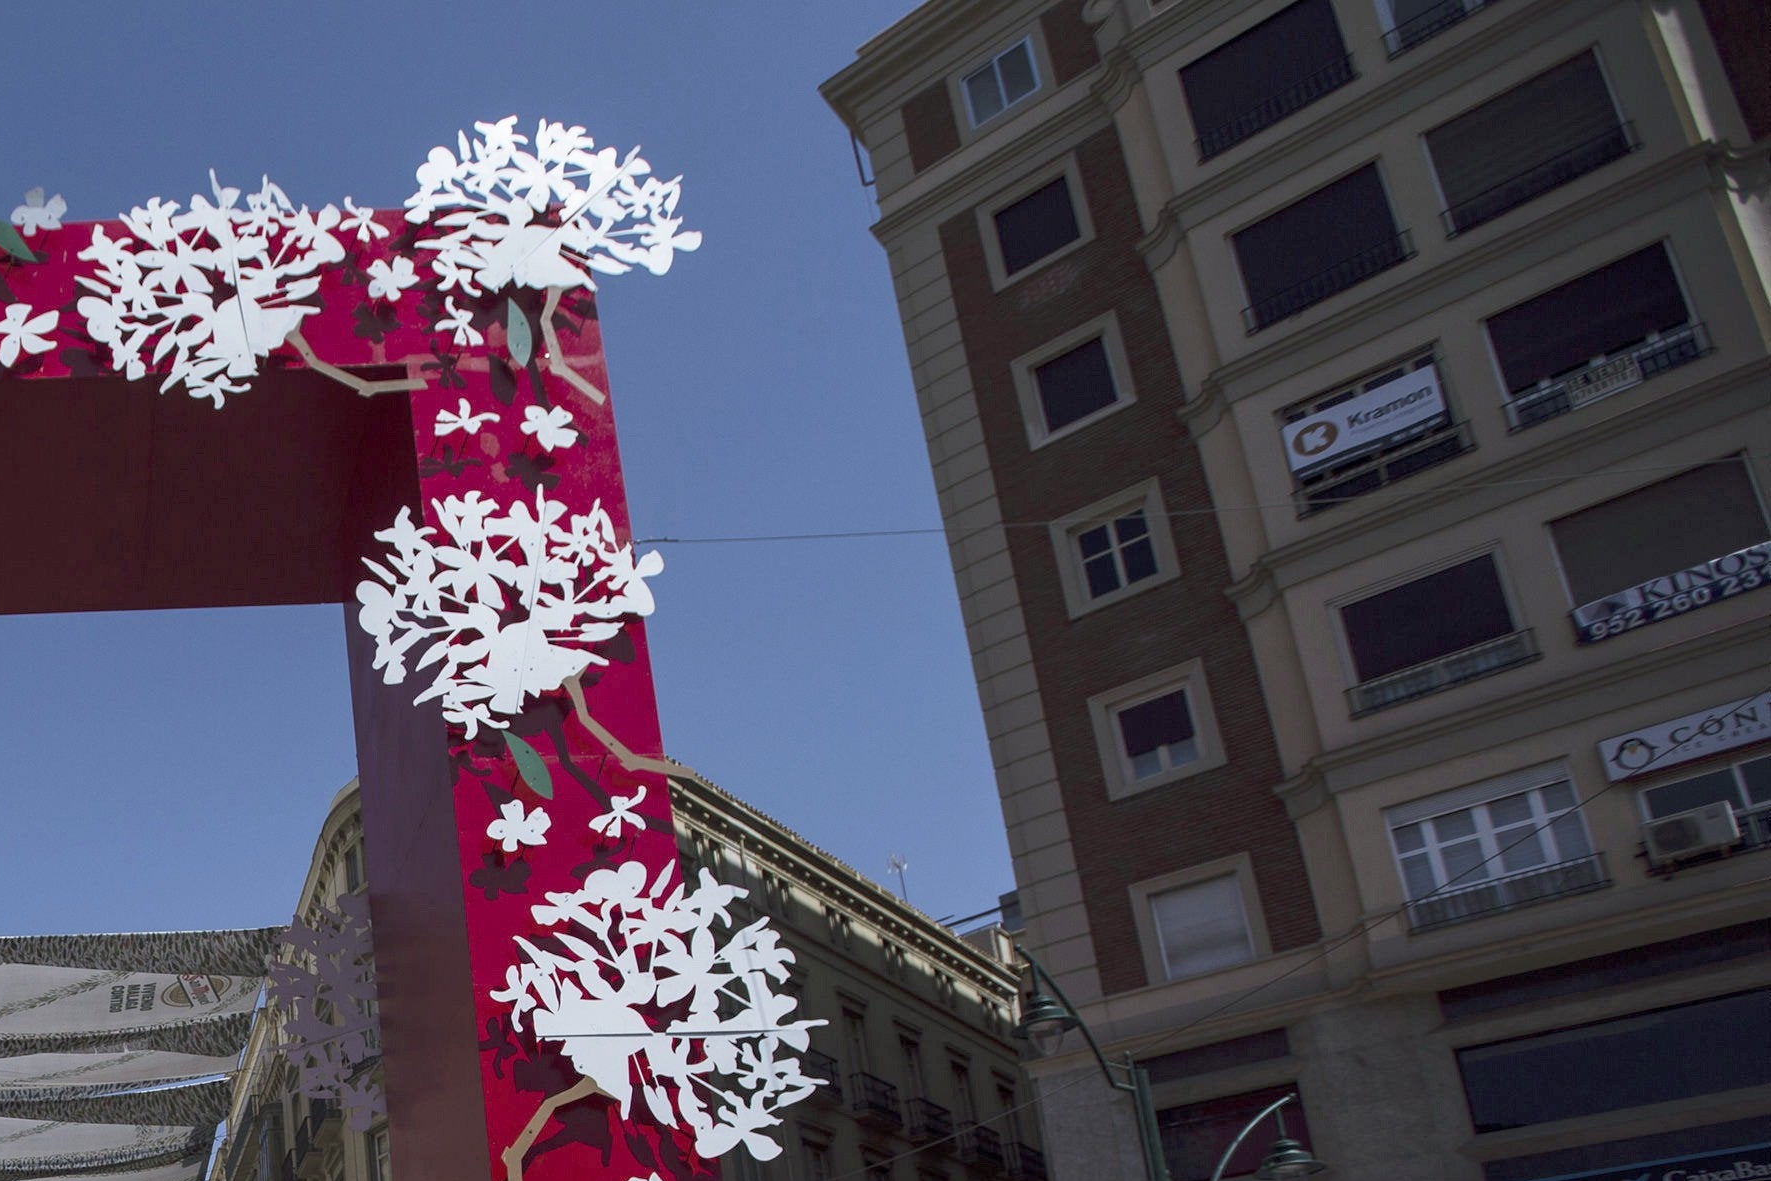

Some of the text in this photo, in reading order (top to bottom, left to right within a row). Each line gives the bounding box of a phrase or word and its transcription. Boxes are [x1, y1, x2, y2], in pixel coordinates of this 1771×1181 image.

[1346, 386, 1433, 429] Kramon
[1638, 550, 1769, 604] KINOS
[1589, 608, 1646, 641] 952
[1652, 586, 1712, 619] 260
[1669, 701, 1771, 744] CÓN
[109, 985, 125, 1013] CONTIGO
